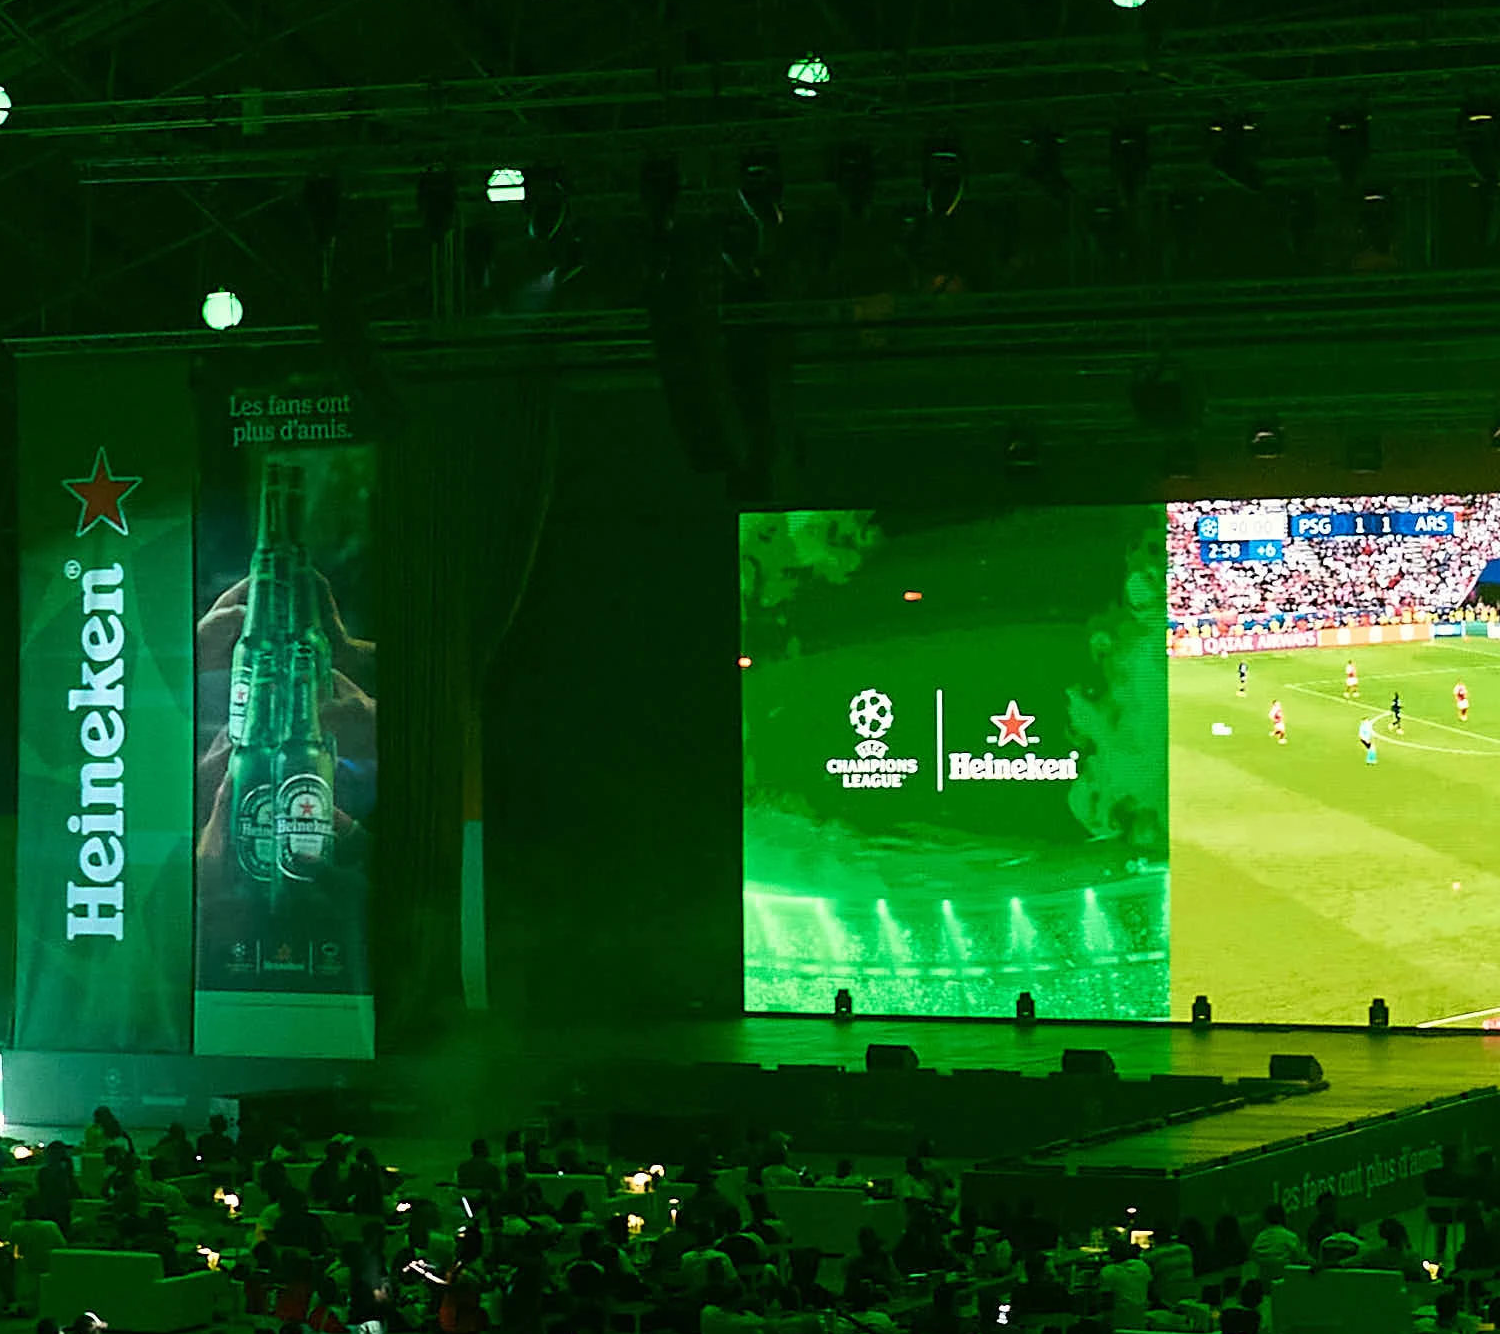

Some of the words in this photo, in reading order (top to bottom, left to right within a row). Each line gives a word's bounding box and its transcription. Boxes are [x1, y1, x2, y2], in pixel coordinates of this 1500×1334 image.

[229, 395, 263, 416] Les
[267, 394, 313, 416] fans
[316, 393, 350, 413] ont
[233, 420, 275, 447] plus
[1299, 519, 1332, 535] PSG
[1355, 517, 1365, 534] 1
[1381, 517, 1392, 533] 1
[1414, 515, 1448, 532] ARS
[1208, 543, 1240, 559] 2:58
[1257, 542, 1277, 558] +6
[67, 561, 125, 942] Heineken
[825, 758, 918, 774] CHAMPIONS
[949, 751, 1079, 780] Heineken
[842, 773, 902, 788] LEAGUE
